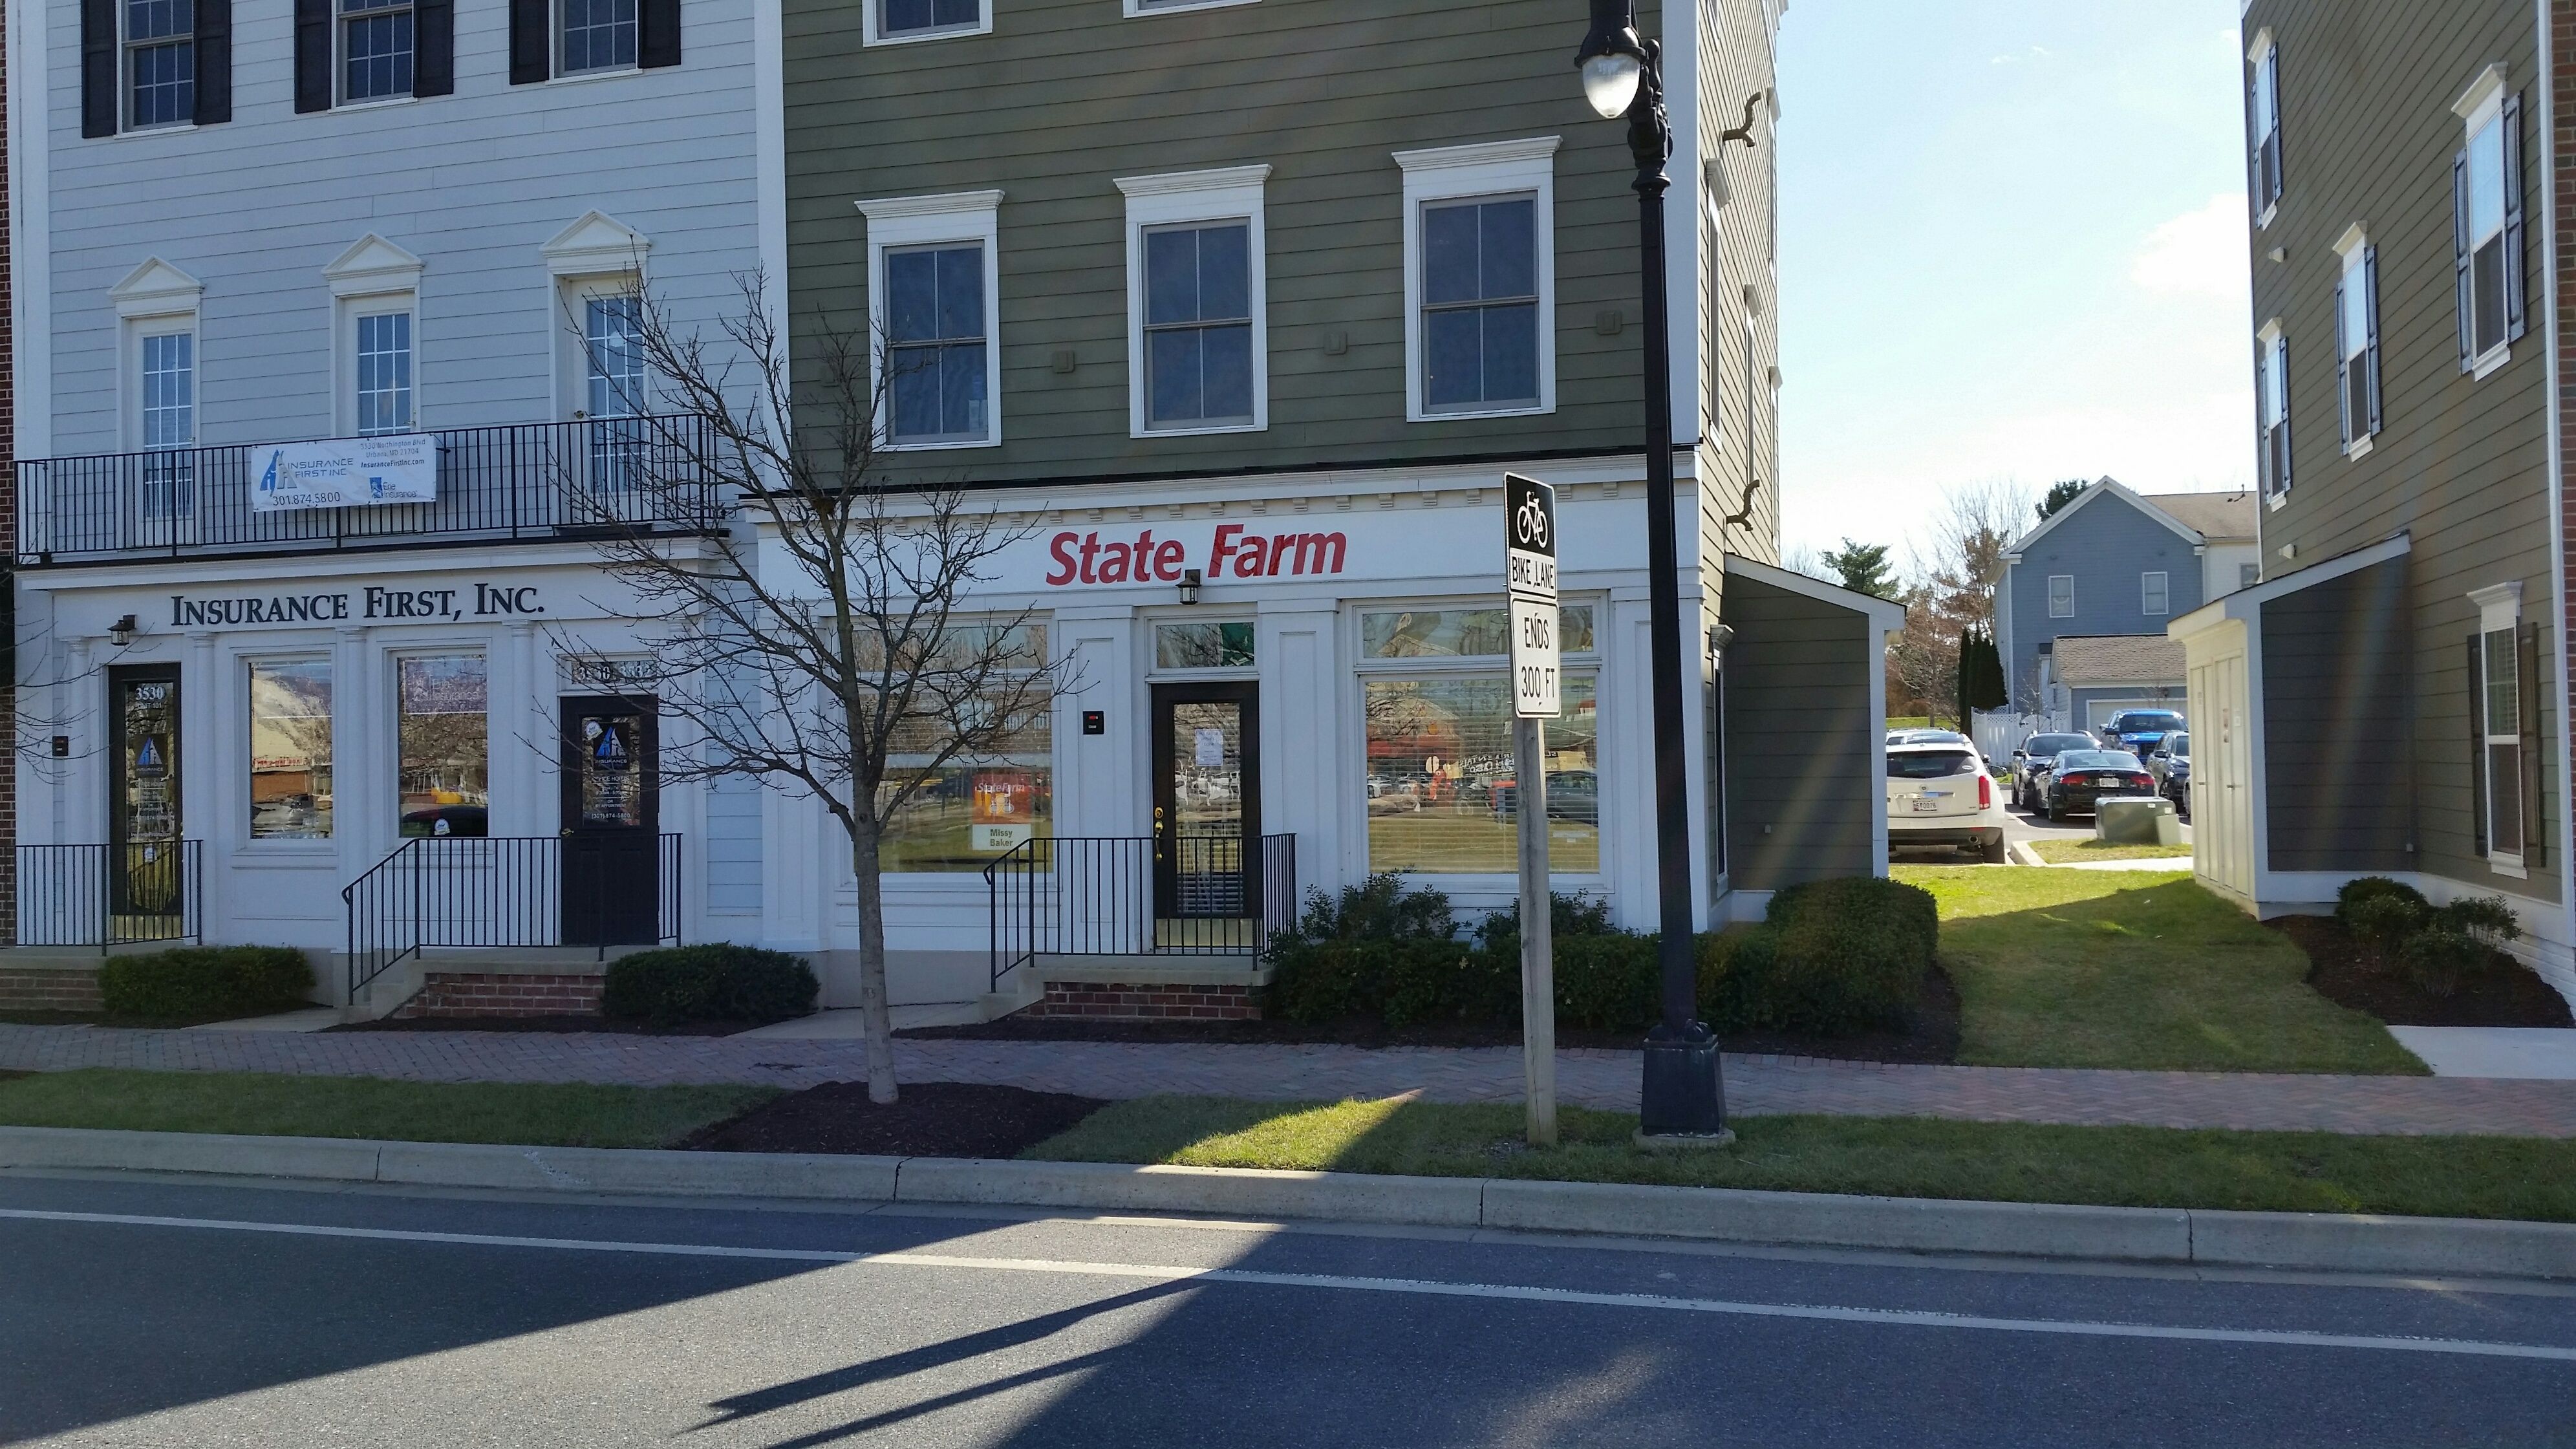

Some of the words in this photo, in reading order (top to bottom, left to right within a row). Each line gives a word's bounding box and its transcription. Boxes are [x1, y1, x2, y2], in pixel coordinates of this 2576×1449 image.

[288, 458, 354, 469] INSURANCE
[361, 459, 424, 468] InsuranceFirstInc.com
[295, 469, 327, 478] FIRST
[329, 468, 347, 477] INC
[273, 491, 341, 506] 301.874.5800
[1046, 529, 1185, 586] State
[1207, 524, 1347, 579] Farm
[1512, 555, 1531, 585] BIKE
[1536, 562, 1554, 590] LANE
[171, 594, 349, 626] INSURANCE
[363, 586, 462, 621] FIRST,
[474, 583, 544, 615] INC.
[1524, 616, 1549, 650] ENDS
[1521, 665, 1541, 698] 300
[1545, 667, 1555, 698] FT
[135, 687, 165, 700] 3530
[990, 828, 1013, 837] Missy
